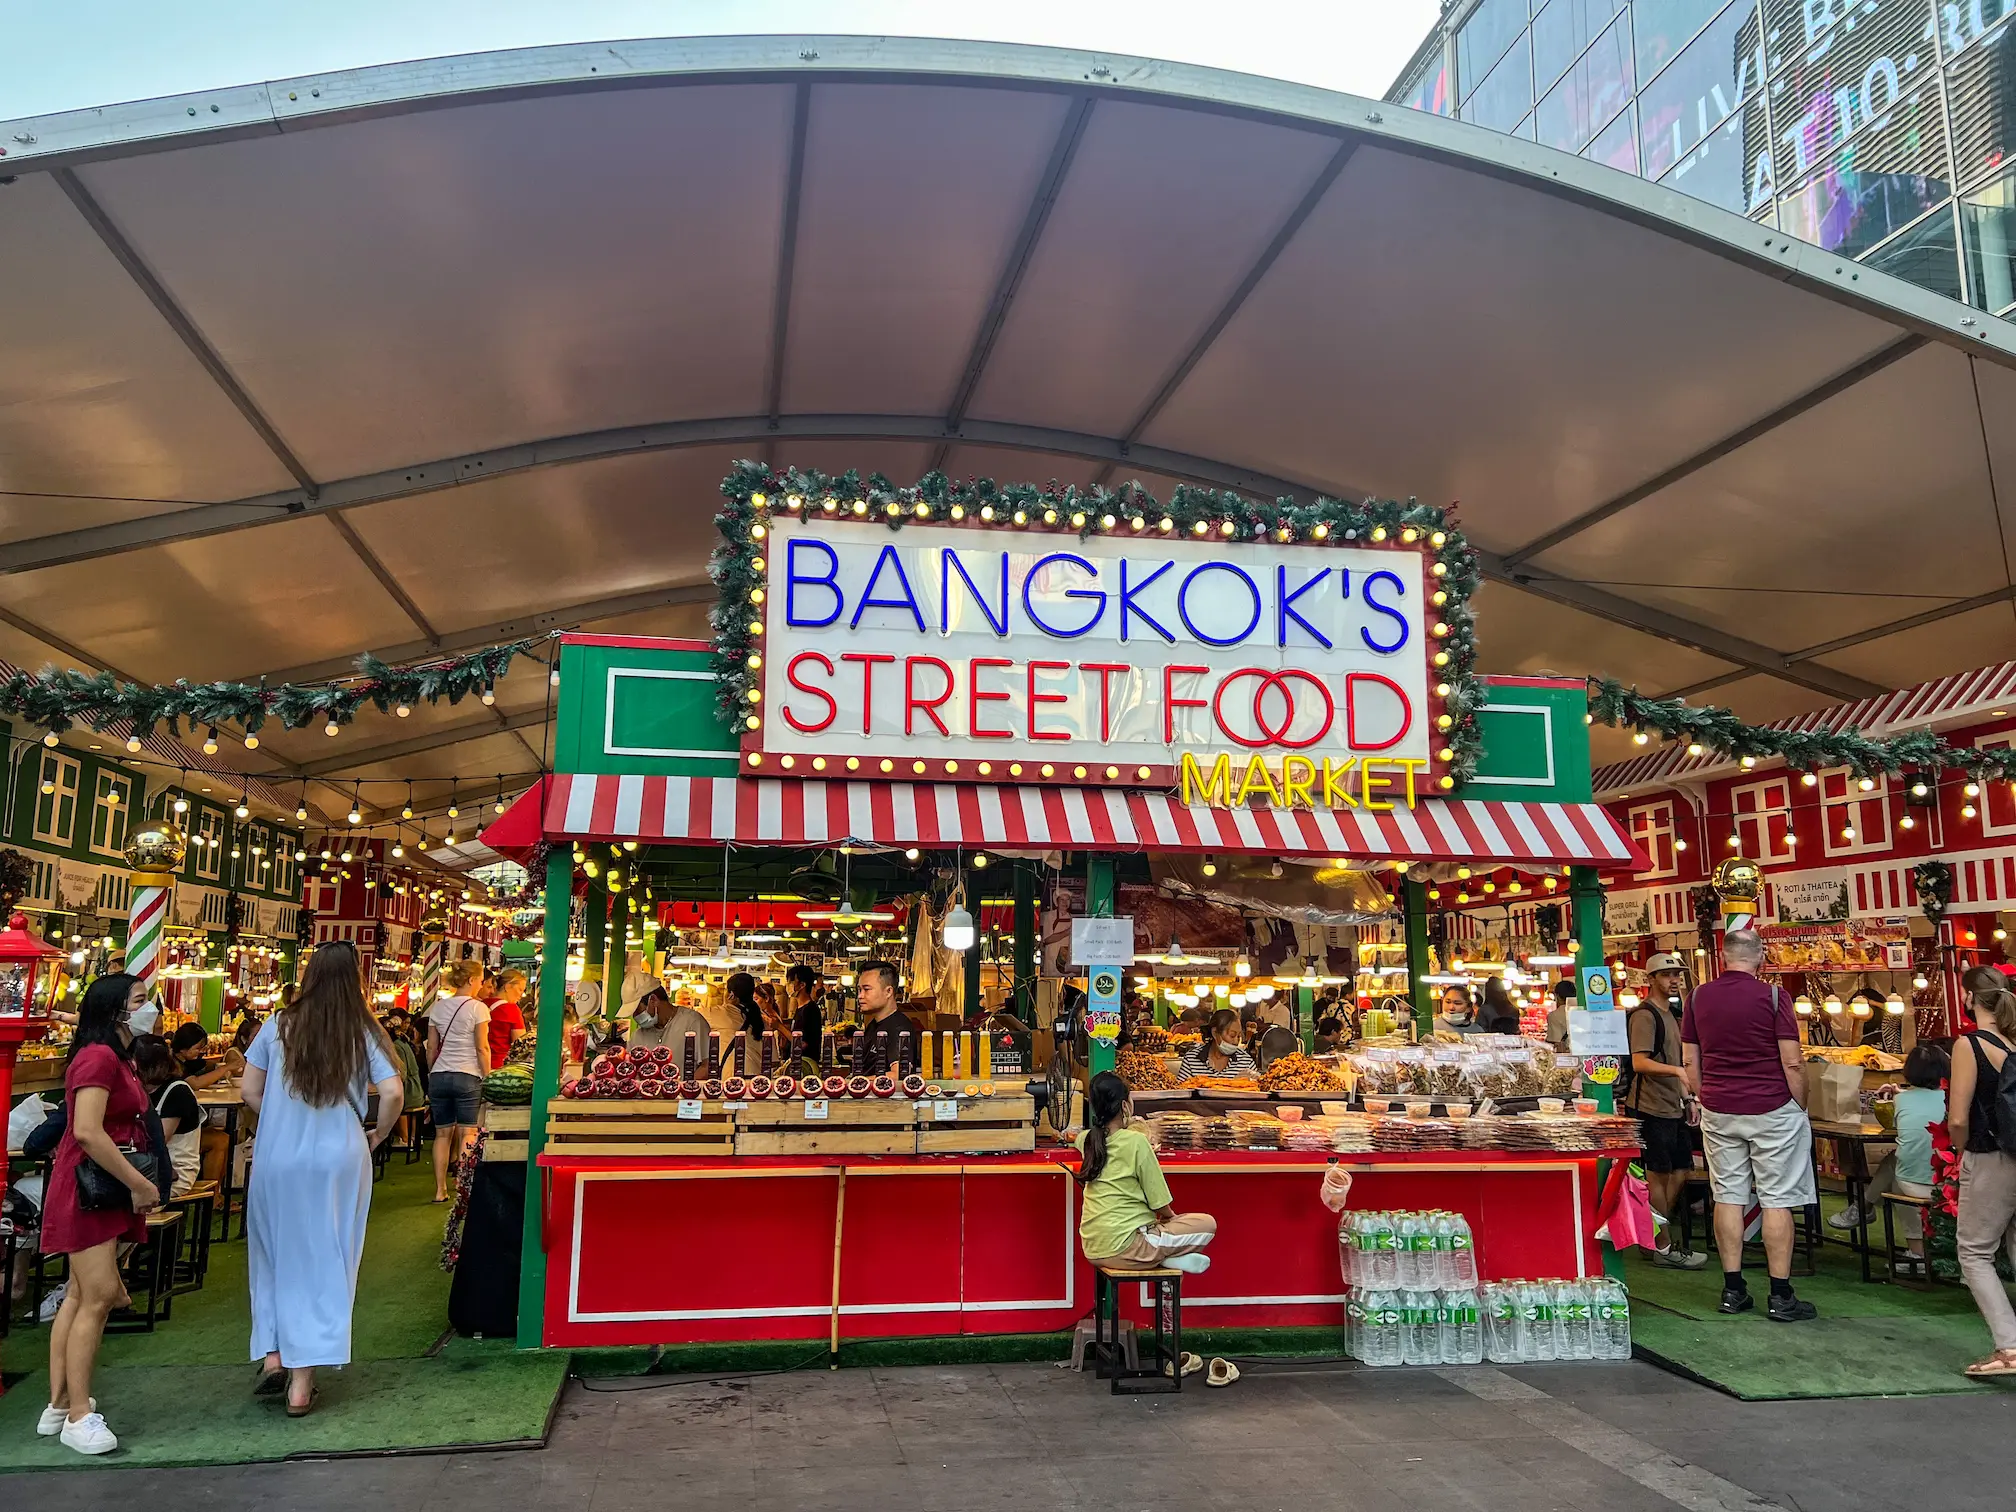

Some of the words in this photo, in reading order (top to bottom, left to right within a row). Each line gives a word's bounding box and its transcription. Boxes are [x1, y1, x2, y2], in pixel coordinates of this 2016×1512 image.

[786, 538, 1409, 654] BANGKOK'S
[783, 651, 1130, 742] STREET
[1163, 665, 1412, 751] FOOD
[1181, 752, 1428, 812] MARKET
[1784, 884, 1800, 893] ROTI
[1801, 883, 1806, 891] &
[1608, 902, 1624, 911] SUPER
[1625, 901, 1639, 909] GRILL
[1095, 1016, 1117, 1025] SALE
[1593, 1059, 1615, 1069] SALE
